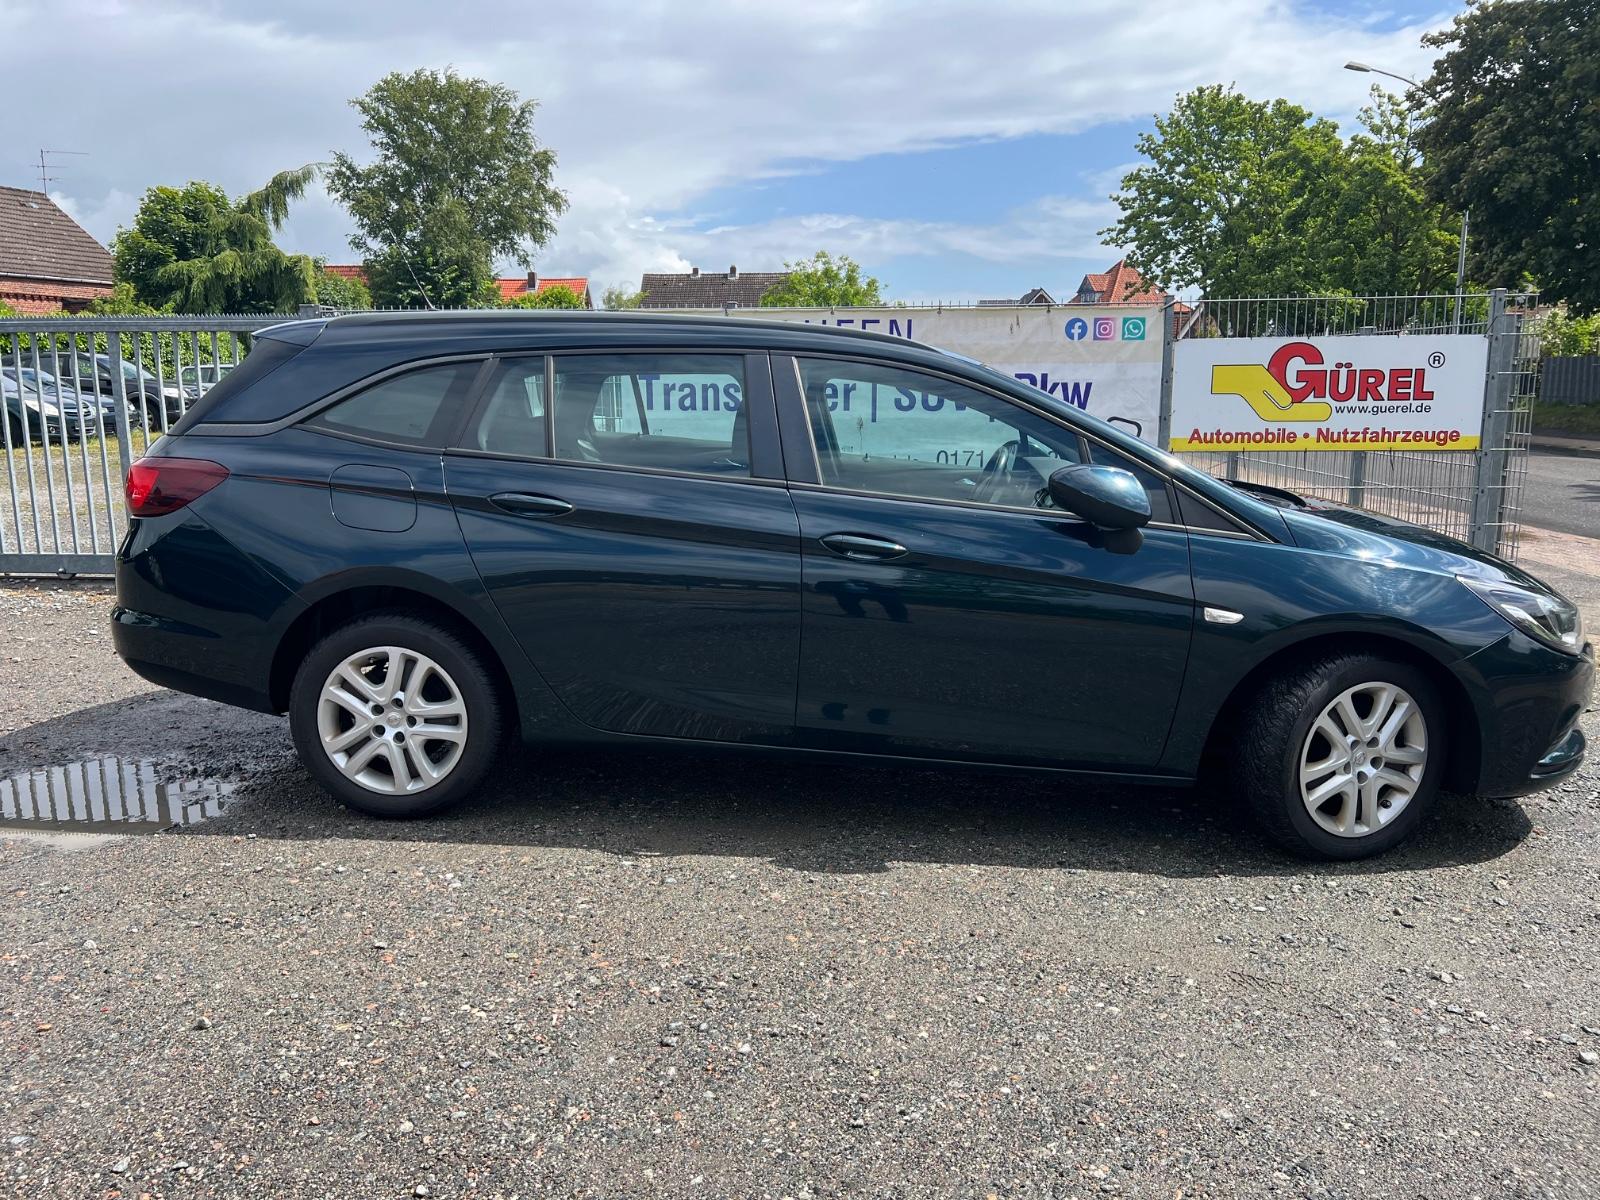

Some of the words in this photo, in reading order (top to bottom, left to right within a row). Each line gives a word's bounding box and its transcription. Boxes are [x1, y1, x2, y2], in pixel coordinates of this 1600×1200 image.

[1268, 341, 1435, 403] GÜREL
[1335, 403, 1432, 416] www.guerel.de
[1188, 428, 1298, 445] Automobile
[1316, 426, 1461, 447] Nutzfahrzeuge
